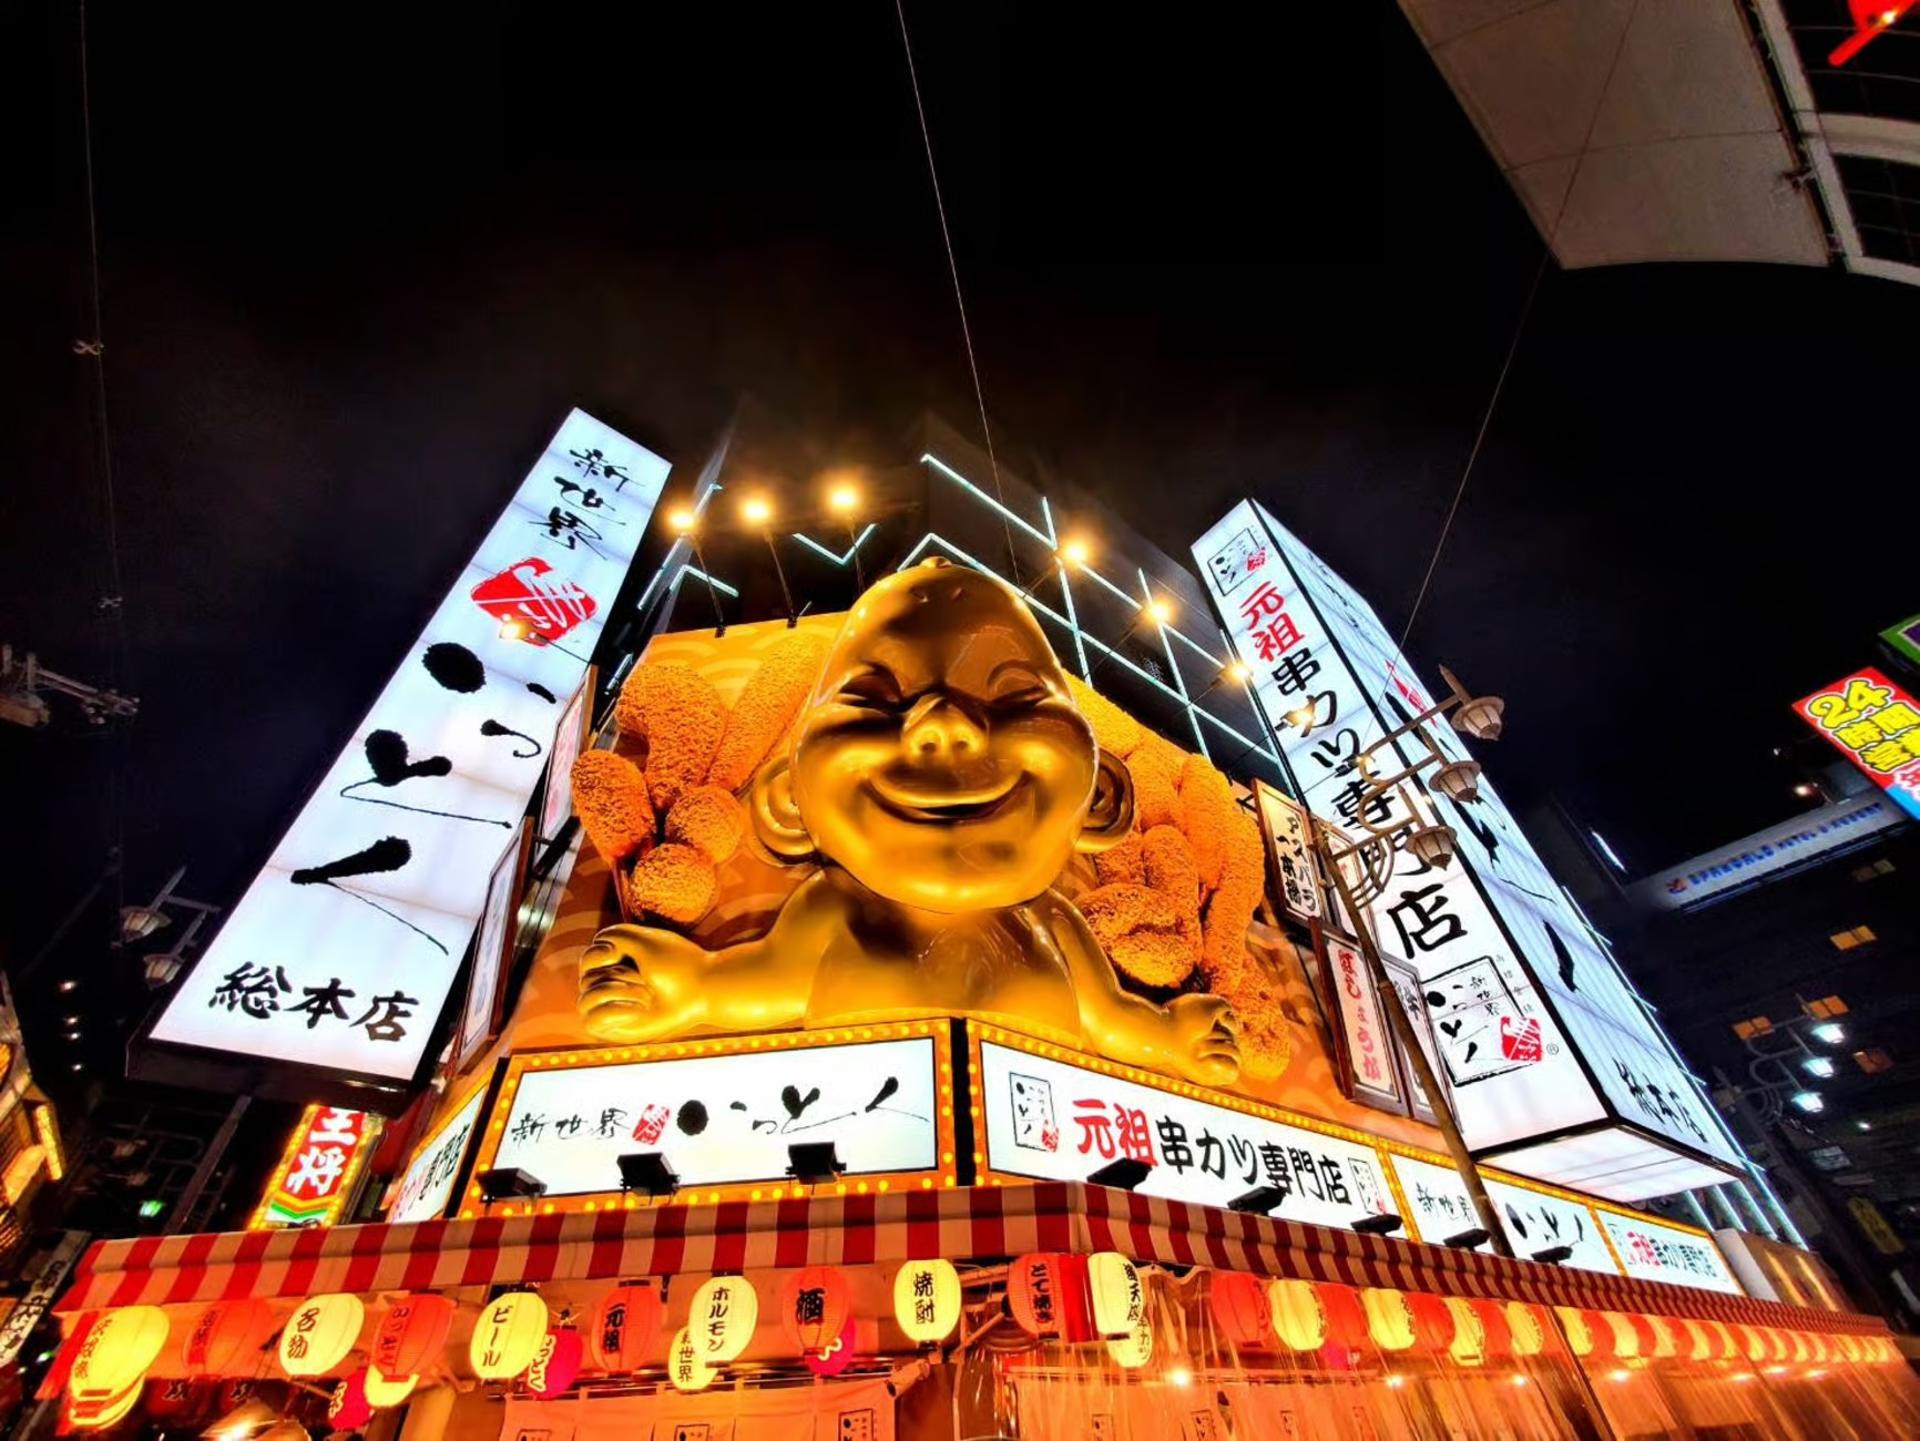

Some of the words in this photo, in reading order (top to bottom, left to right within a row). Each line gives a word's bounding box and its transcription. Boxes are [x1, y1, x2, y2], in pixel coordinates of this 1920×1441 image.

[528, 449, 645, 561] 新世界
[1809, 679, 1891, 728] 24
[208, 962, 418, 1043] 総本店
[286, 1107, 358, 1195] 王将
[511, 1107, 632, 1144] 新世界
[1073, 1098, 1352, 1206] 元祖串カツ専門店
[707, 1286, 731, 1352] ホルモン
[913, 1270, 935, 1326] 焼酎
[288, 1307, 321, 1359] 名物
[482, 1304, 514, 1368] ビール
